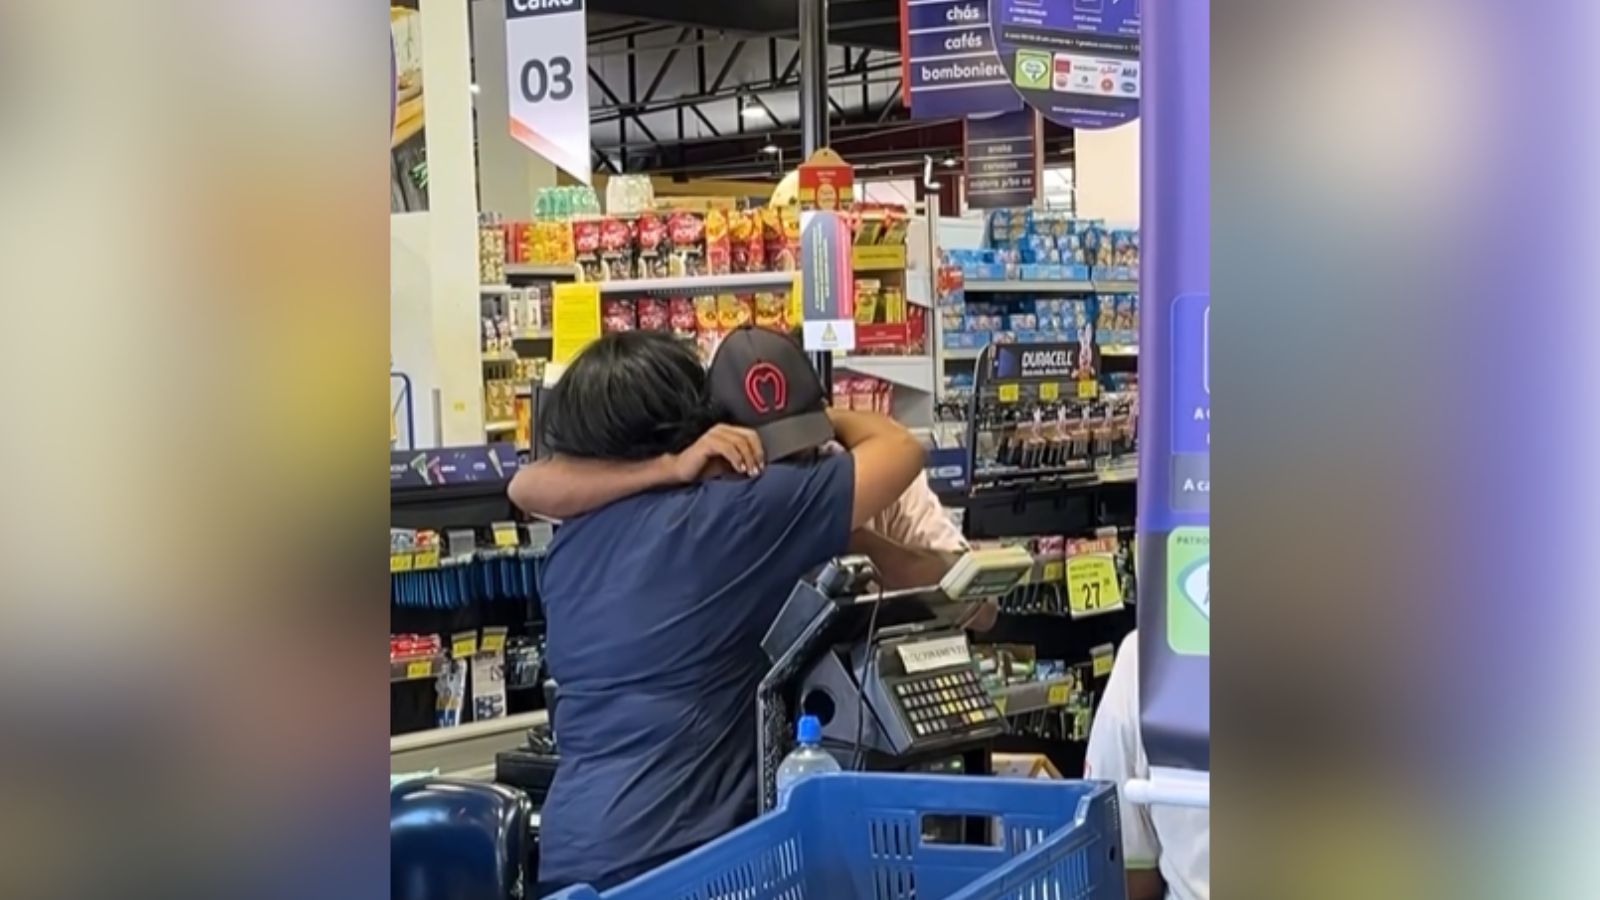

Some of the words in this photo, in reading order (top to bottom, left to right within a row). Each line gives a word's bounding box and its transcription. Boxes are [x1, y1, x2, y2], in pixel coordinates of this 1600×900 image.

[946, 4, 979, 21] chás
[944, 32, 982, 50] cafés
[520, 56, 573, 103] 03
[1021, 350, 1073, 367] DURACELL
[1183, 477, 1194, 491] A
[1082, 582, 1100, 610] 27
